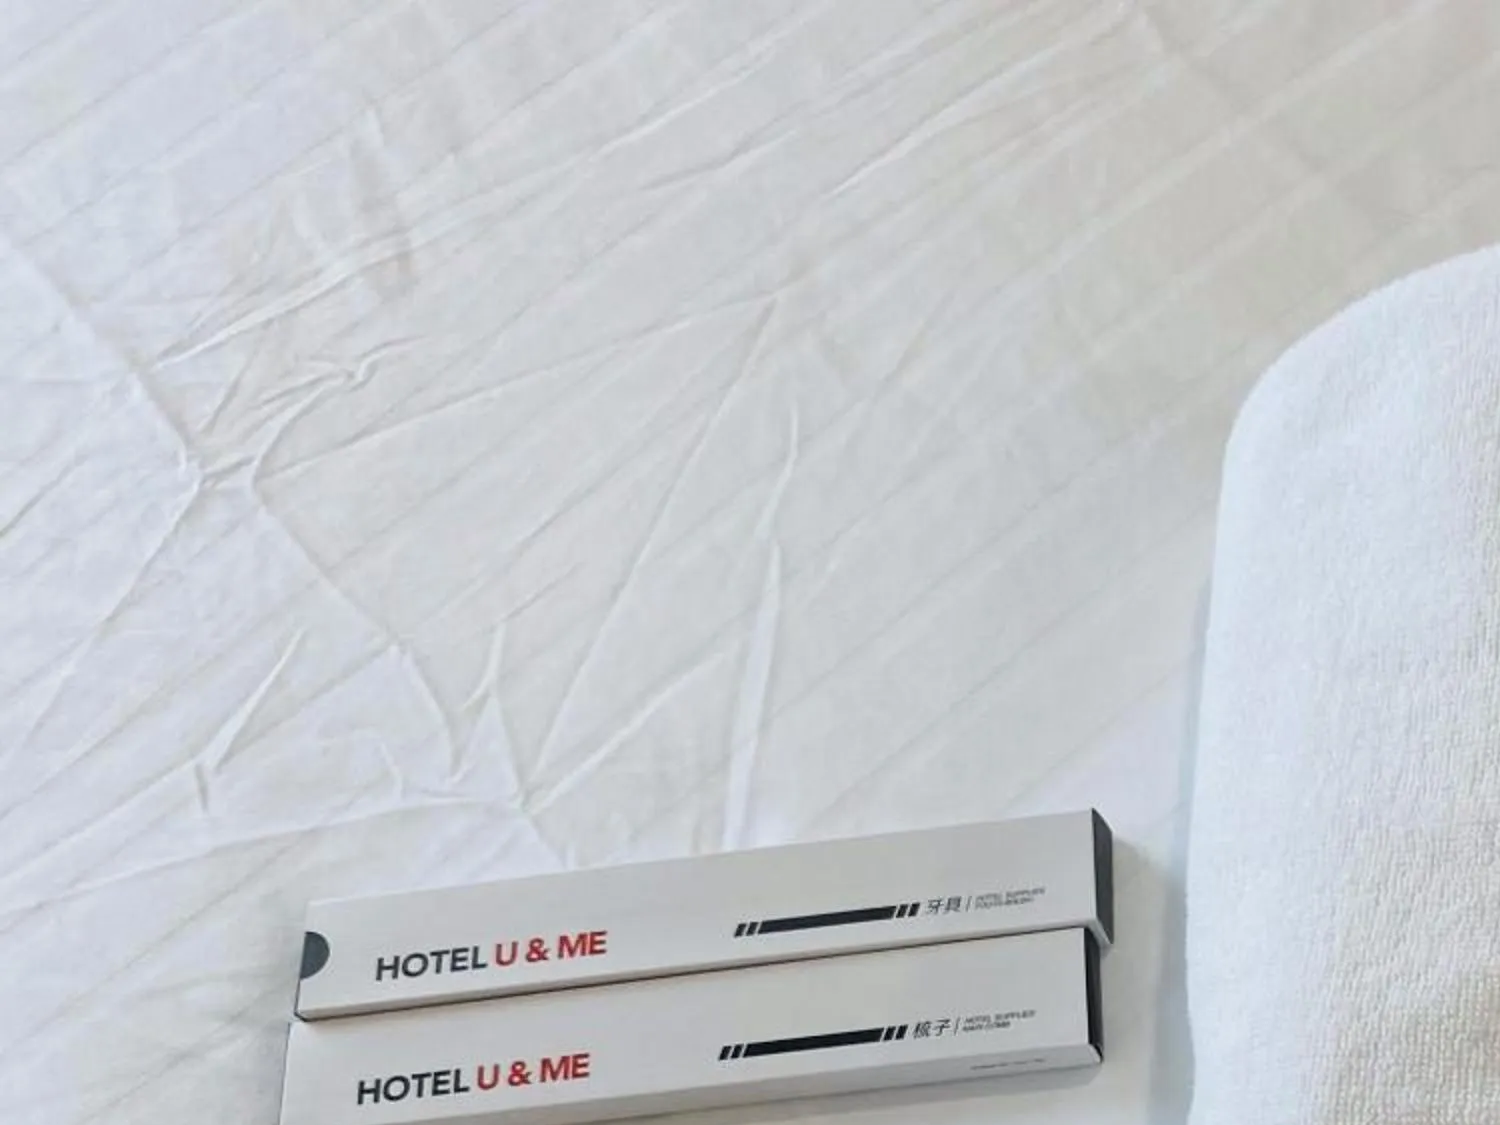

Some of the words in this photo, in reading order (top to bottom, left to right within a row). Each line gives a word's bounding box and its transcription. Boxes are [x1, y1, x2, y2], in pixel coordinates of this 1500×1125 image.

[375, 946, 488, 981] HOTEL
[494, 941, 519, 967] U
[524, 937, 550, 963] &
[557, 930, 608, 960] ME
[356, 1069, 470, 1105] HOTEL
[476, 1064, 501, 1091] U
[507, 1060, 532, 1086] &
[539, 1053, 591, 1082] ME
